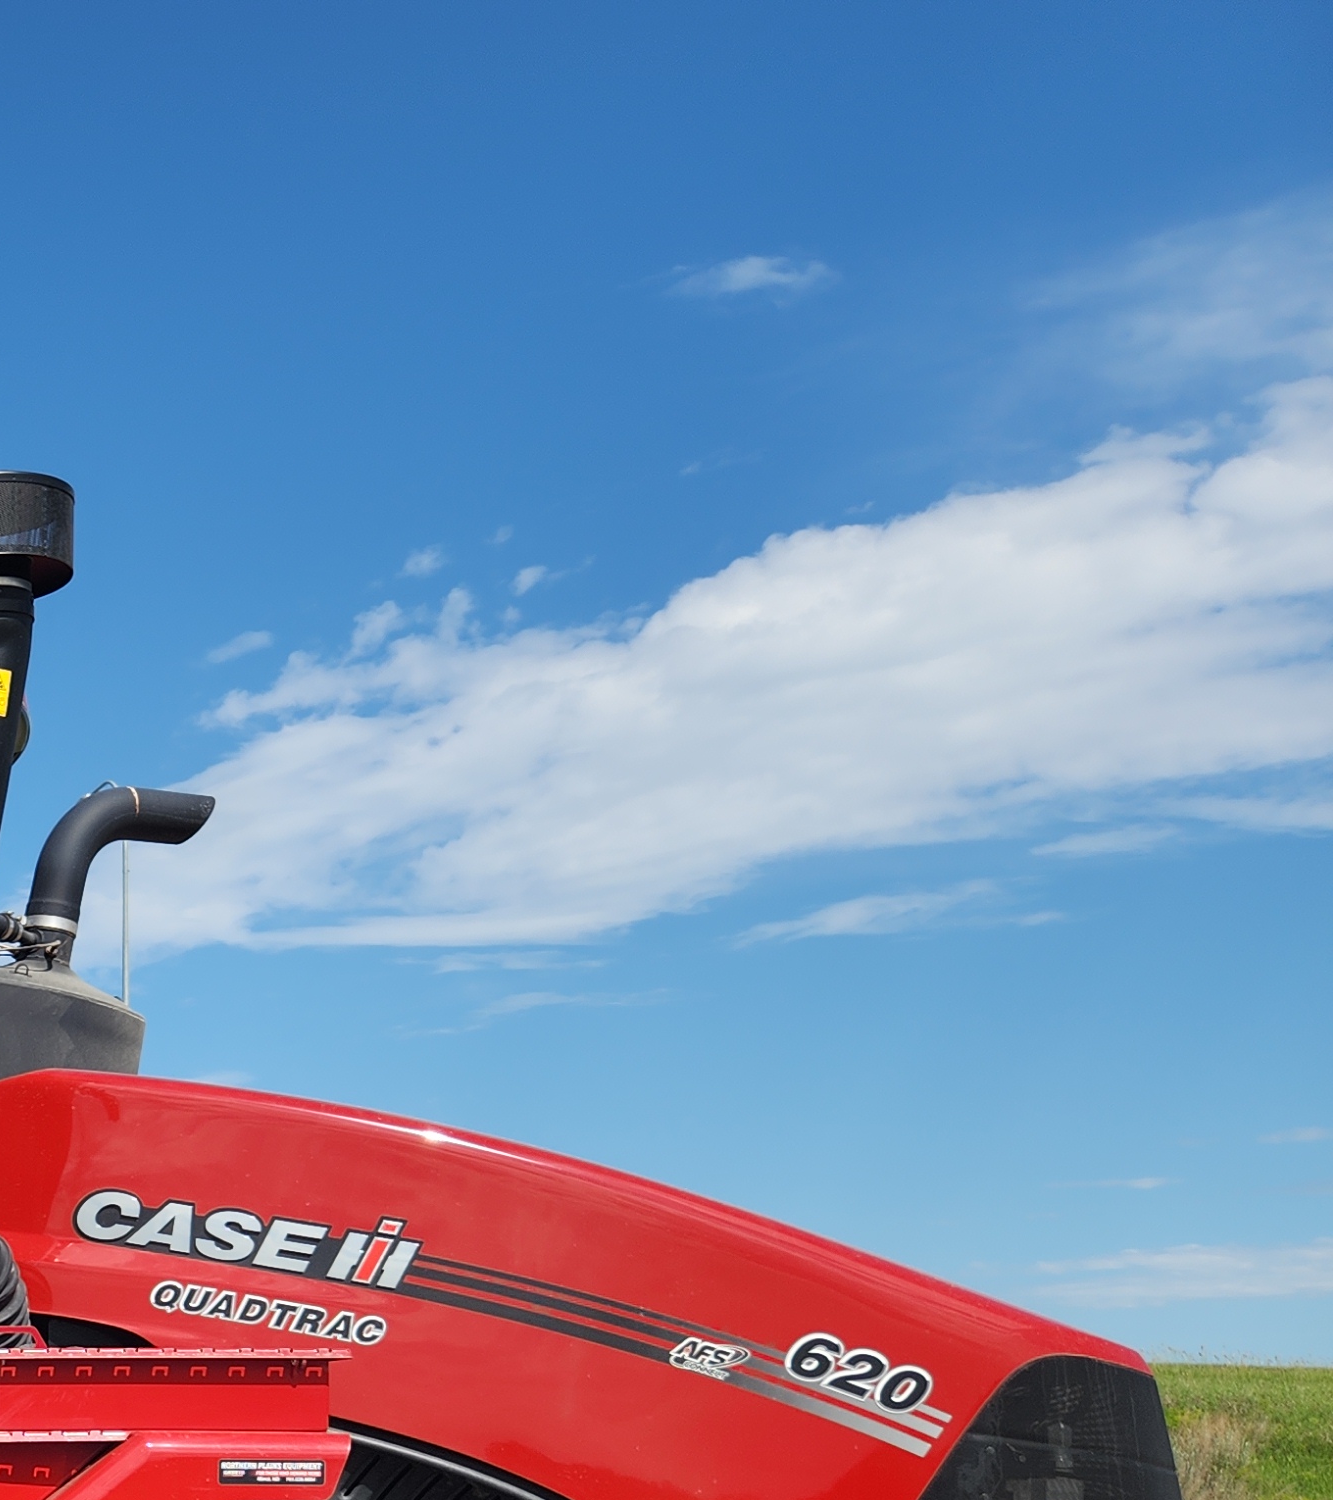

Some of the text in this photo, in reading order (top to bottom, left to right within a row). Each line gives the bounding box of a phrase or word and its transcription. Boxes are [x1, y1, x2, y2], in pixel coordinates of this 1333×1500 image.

[76, 1190, 330, 1273] CASE
[150, 1281, 387, 1345] QUADTRAC
[673, 1338, 733, 1365] AFS
[684, 1361, 730, 1380] CONNECT
[786, 1333, 933, 1414] 620
[258, 1462, 282, 1470] PLAINS
[282, 1462, 323, 1471] EQUIPMENT
